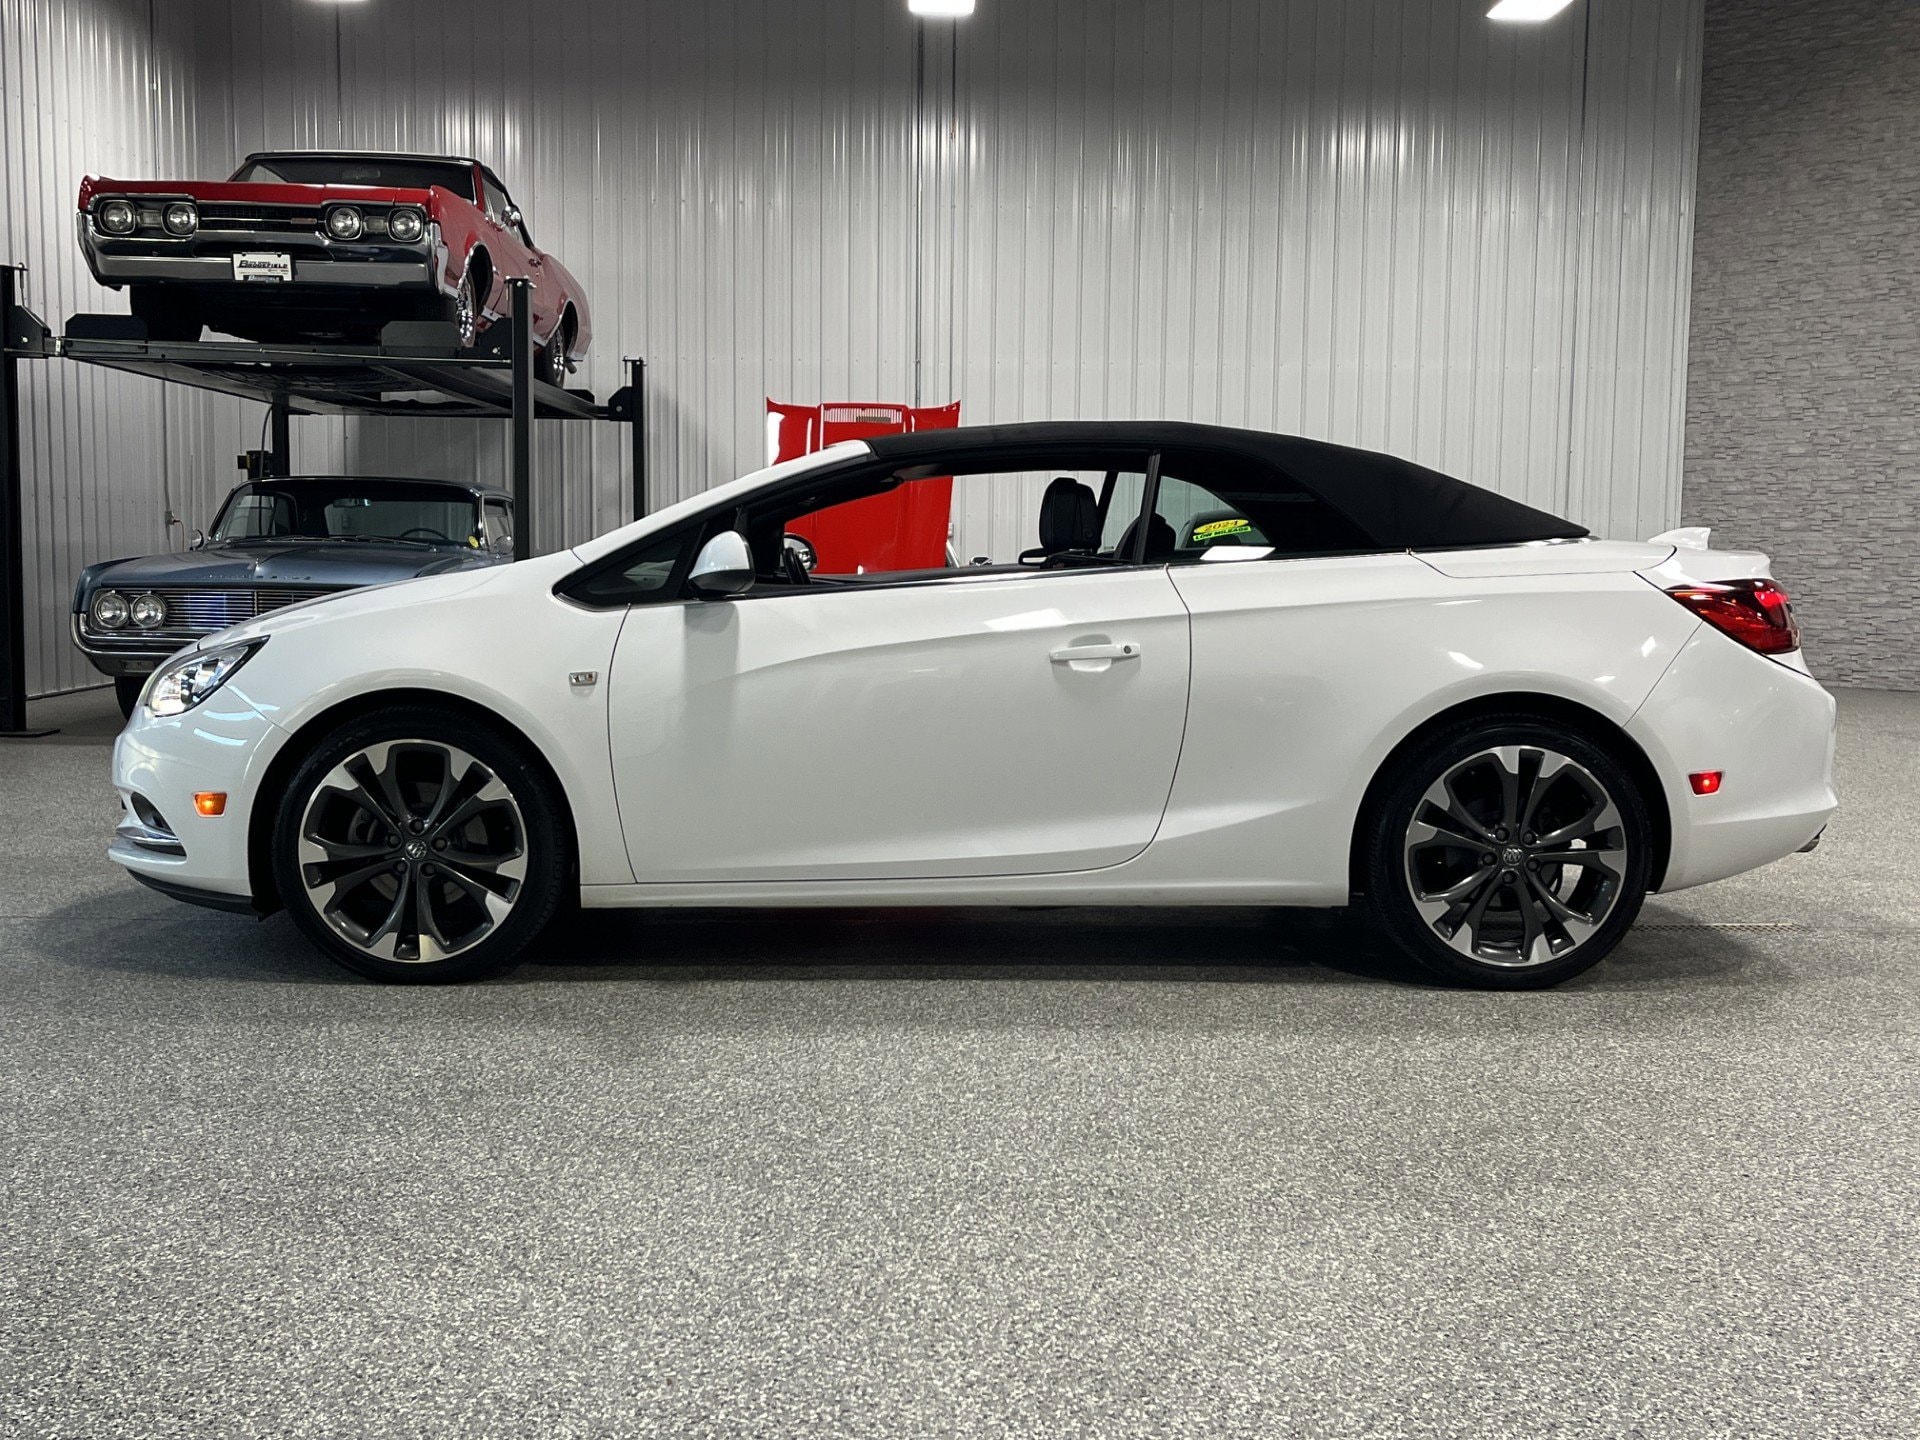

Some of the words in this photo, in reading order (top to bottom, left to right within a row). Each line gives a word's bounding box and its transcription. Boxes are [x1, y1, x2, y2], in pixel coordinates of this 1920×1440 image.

[1205, 521, 1238, 532] 2024
[1195, 532, 1212, 540] LOW
[1214, 526, 1249, 536] MILEAGE
